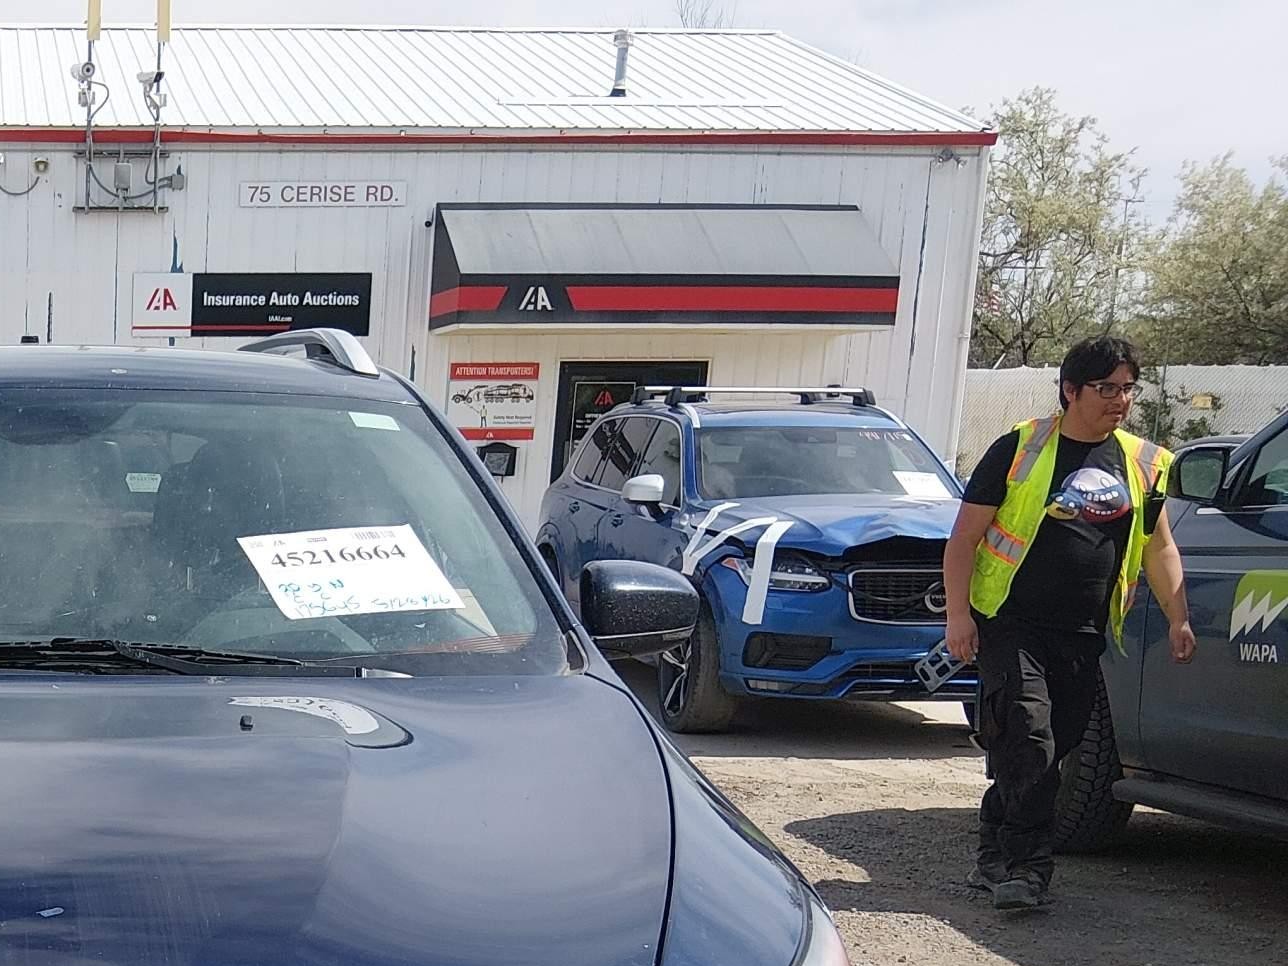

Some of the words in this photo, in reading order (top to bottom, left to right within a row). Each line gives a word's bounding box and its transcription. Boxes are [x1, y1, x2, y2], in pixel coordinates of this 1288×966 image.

[247, 185, 271, 203] 75
[280, 185, 356, 203] CERISE
[365, 185, 399, 202] RD.
[203, 291, 266, 307] Insurance
[269, 291, 300, 307] Auto
[302, 291, 360, 307] Auctions
[455, 366, 487, 376] ATTENTION
[488, 366, 534, 376] TRANSPORTERS!
[271, 543, 407, 568] 45216664
[1239, 642, 1278, 663] WAPA
